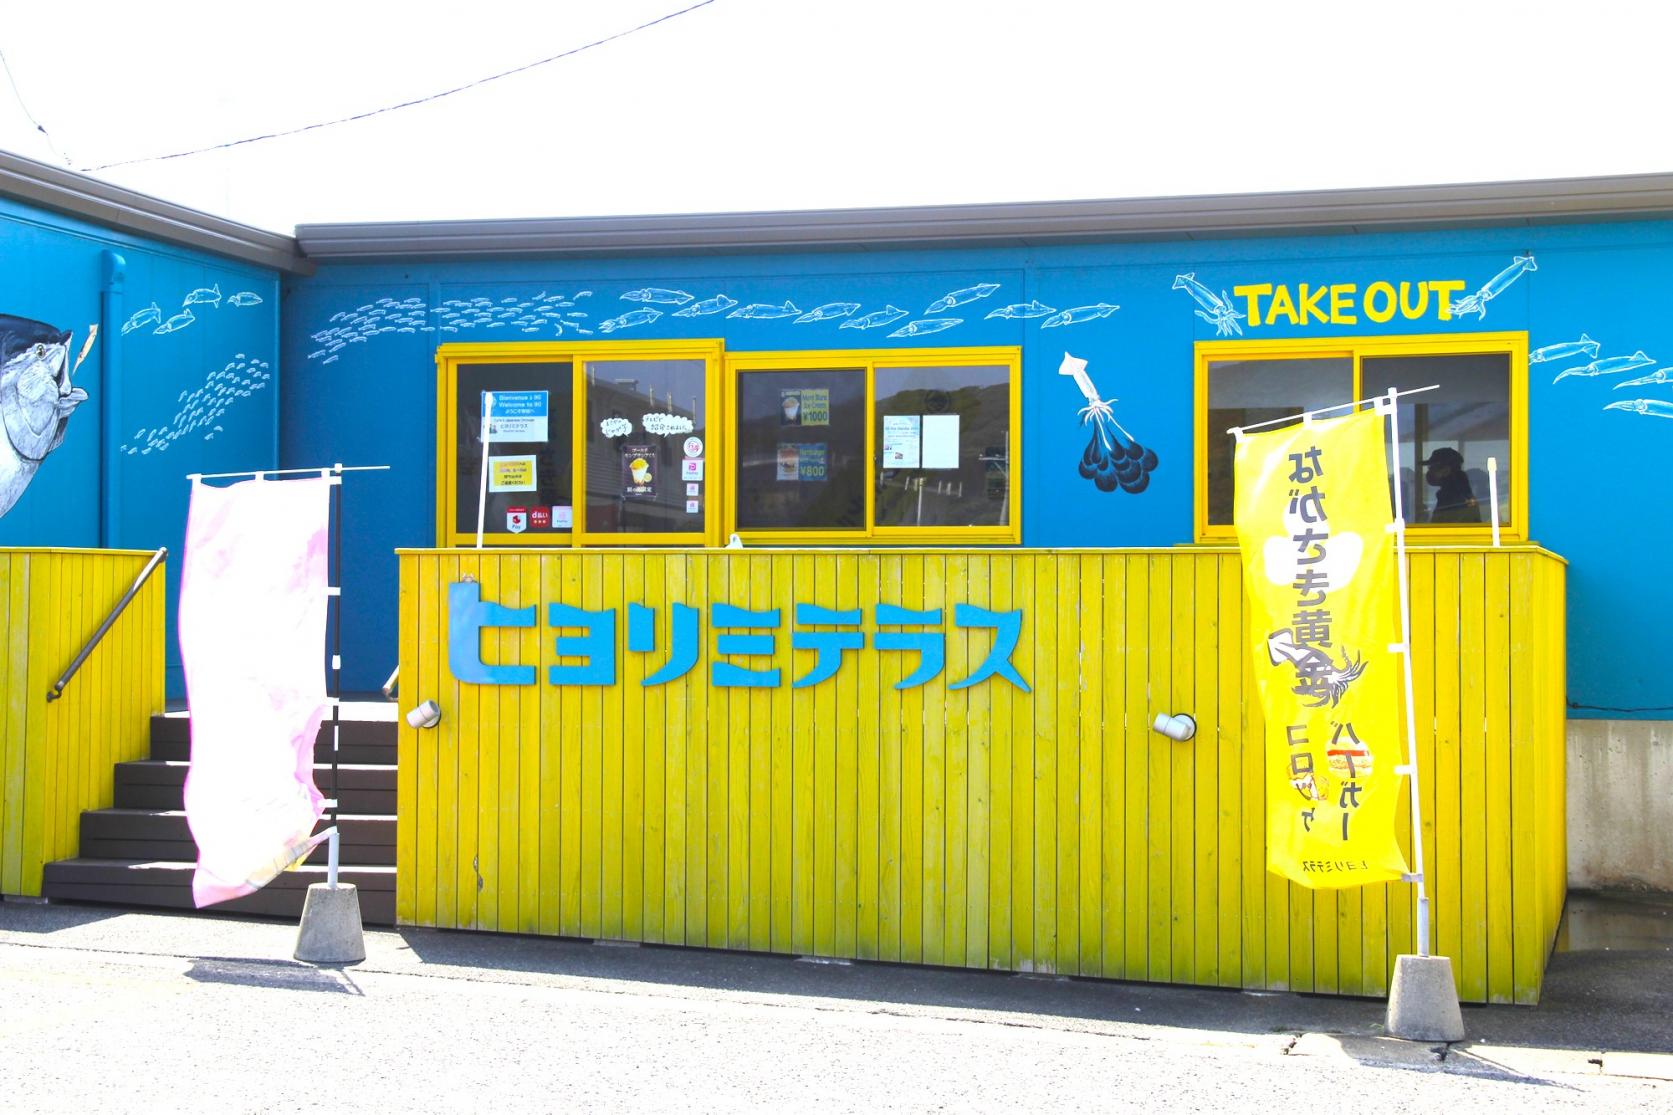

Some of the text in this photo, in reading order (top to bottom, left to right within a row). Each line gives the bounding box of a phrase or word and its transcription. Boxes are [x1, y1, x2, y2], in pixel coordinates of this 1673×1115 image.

[1234, 280, 1465, 326] TAKE OUT
[802, 411, 828, 421] ¥1000
[800, 465, 825, 476] ¥800
[448, 581, 1031, 693] ヒヨリミテラス
